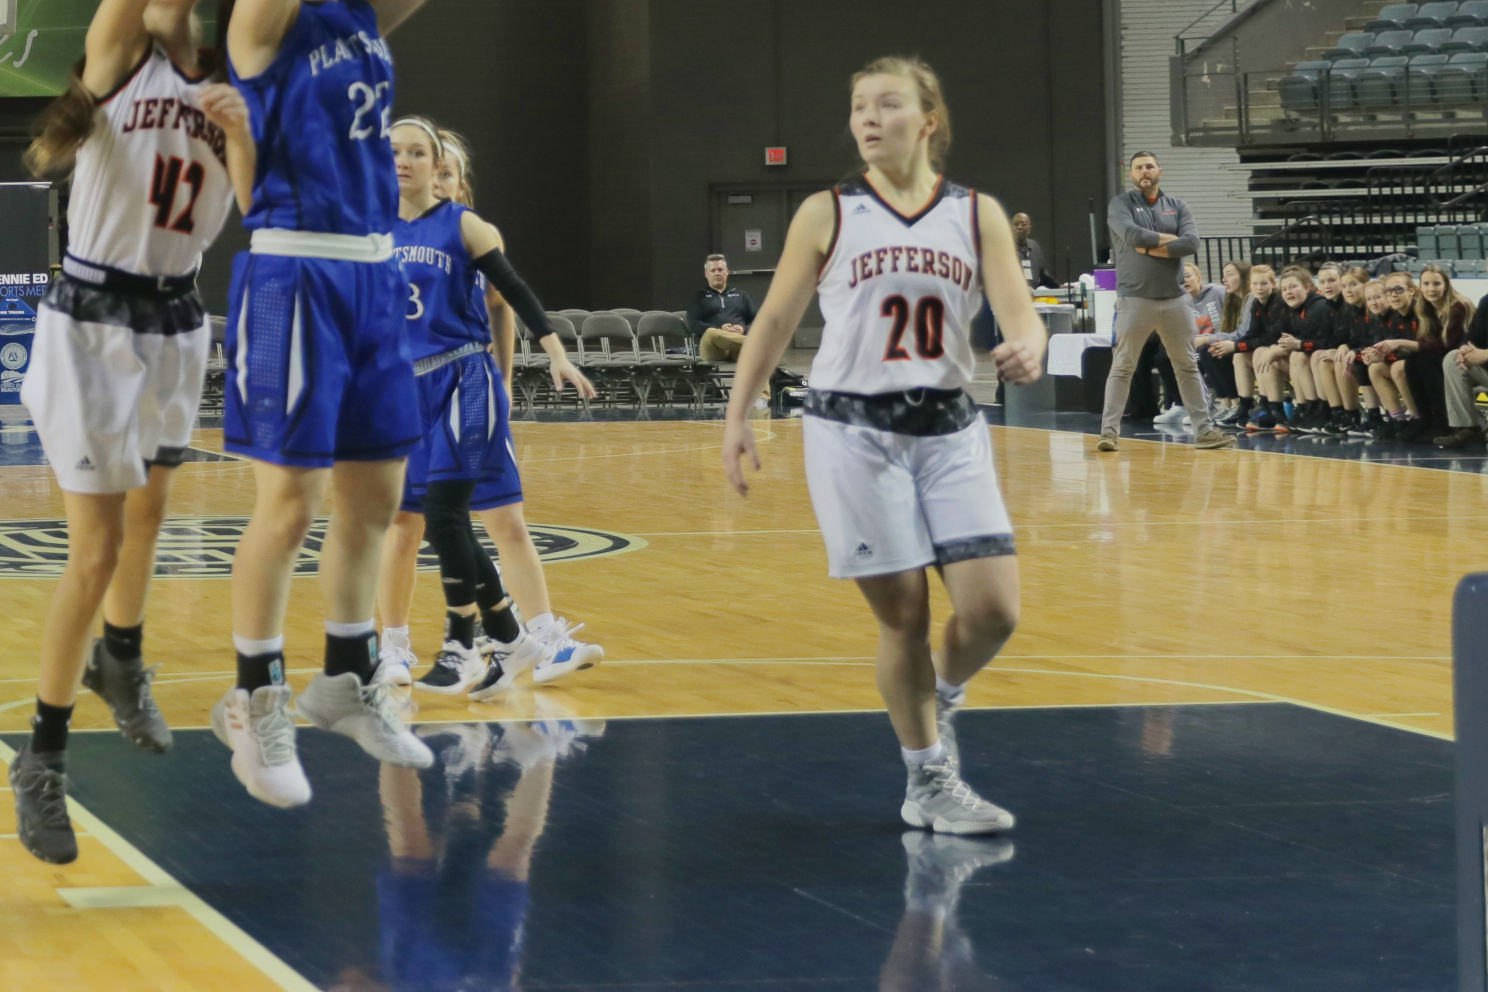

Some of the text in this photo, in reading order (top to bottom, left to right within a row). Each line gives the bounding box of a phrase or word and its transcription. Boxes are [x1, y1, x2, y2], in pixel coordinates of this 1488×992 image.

[148, 151, 205, 236] 42
[32, 273, 48, 284] ED
[848, 246, 973, 292] JEFFERSON
[879, 293, 945, 362] 20
